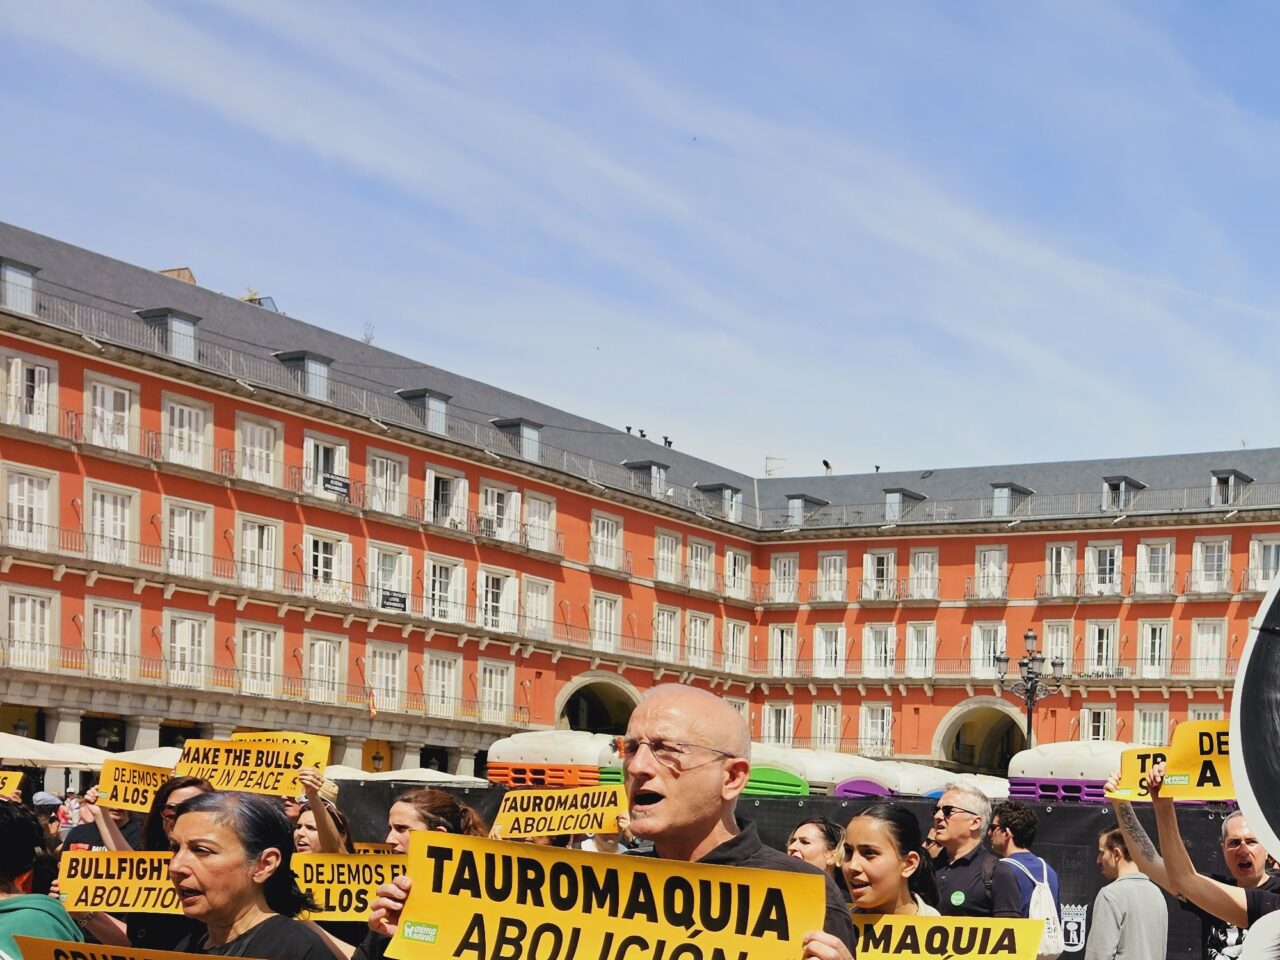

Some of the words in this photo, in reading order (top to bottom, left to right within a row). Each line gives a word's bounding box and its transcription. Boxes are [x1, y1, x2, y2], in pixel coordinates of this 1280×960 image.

[178, 746, 221, 765] MAKE
[224, 748, 252, 767] THE
[254, 750, 305, 770] BULLS
[113, 767, 158, 788] DEJEMOS
[216, 768, 236, 787] IN
[234, 769, 284, 791] PEACE
[1196, 760, 1221, 787] A
[109, 787, 119, 801] A
[122, 787, 149, 805] LOS
[502, 791, 618, 813] TAUROMAQUIA
[509, 807, 604, 833] ABOLICIÓN
[303, 863, 385, 885] DEJEMOS
[74, 885, 182, 910] ABOLITIO
[324, 888, 369, 913] LOS
[426, 845, 790, 942] TAUROMAQUIA
